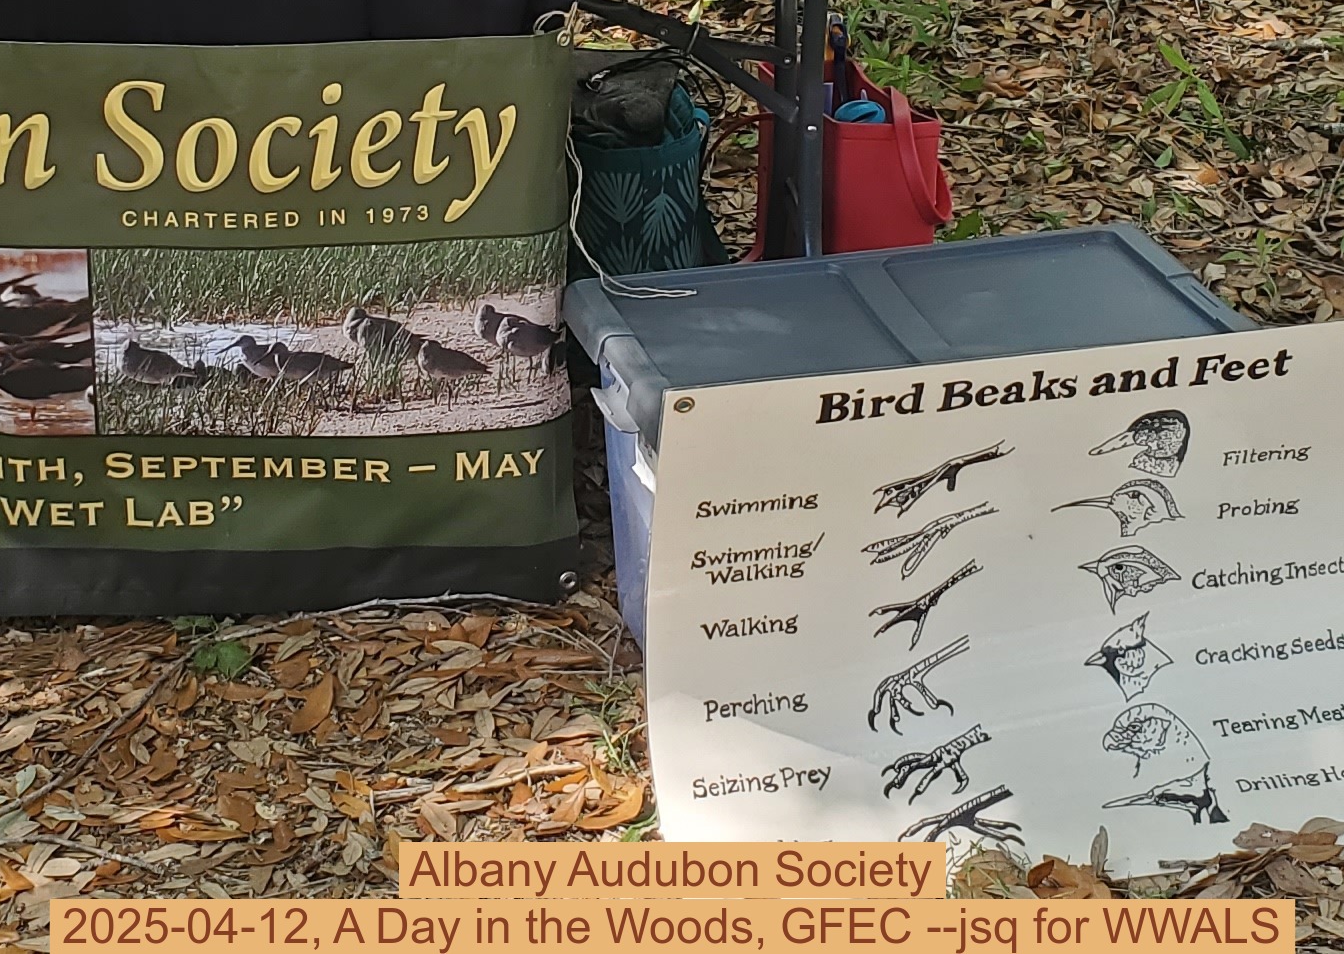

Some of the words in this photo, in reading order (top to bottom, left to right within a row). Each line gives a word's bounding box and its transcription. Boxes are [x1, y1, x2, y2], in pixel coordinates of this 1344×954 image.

[94, 80, 520, 224] Society
[121, 210, 301, 229] CHARTERED
[318, 209, 347, 227] IN
[365, 204, 431, 225] 1973
[815, 382, 925, 424] Bird
[936, 370, 1078, 412] Beaks
[1088, 357, 1178, 397] and
[1188, 348, 1294, 386] Feet
[105, 451, 391, 484] SEPTEMBER
[455, 448, 545, 482] MAY
[1222, 444, 1312, 467] Filtering
[695, 493, 819, 519] Swimming
[1216, 498, 1301, 519] Probing
[690, 531, 826, 570] Swimming/
[705, 561, 806, 585] Walking
[1191, 561, 1283, 590] Catching
[699, 613, 799, 639] Walking
[1195, 641, 1289, 665] Cracking
[703, 691, 809, 722] Perching
[1212, 713, 1300, 737] Tearing
[692, 774, 780, 800] Seizing
[779, 766, 832, 791] Prey
[1235, 773, 1321, 793] Drilling
